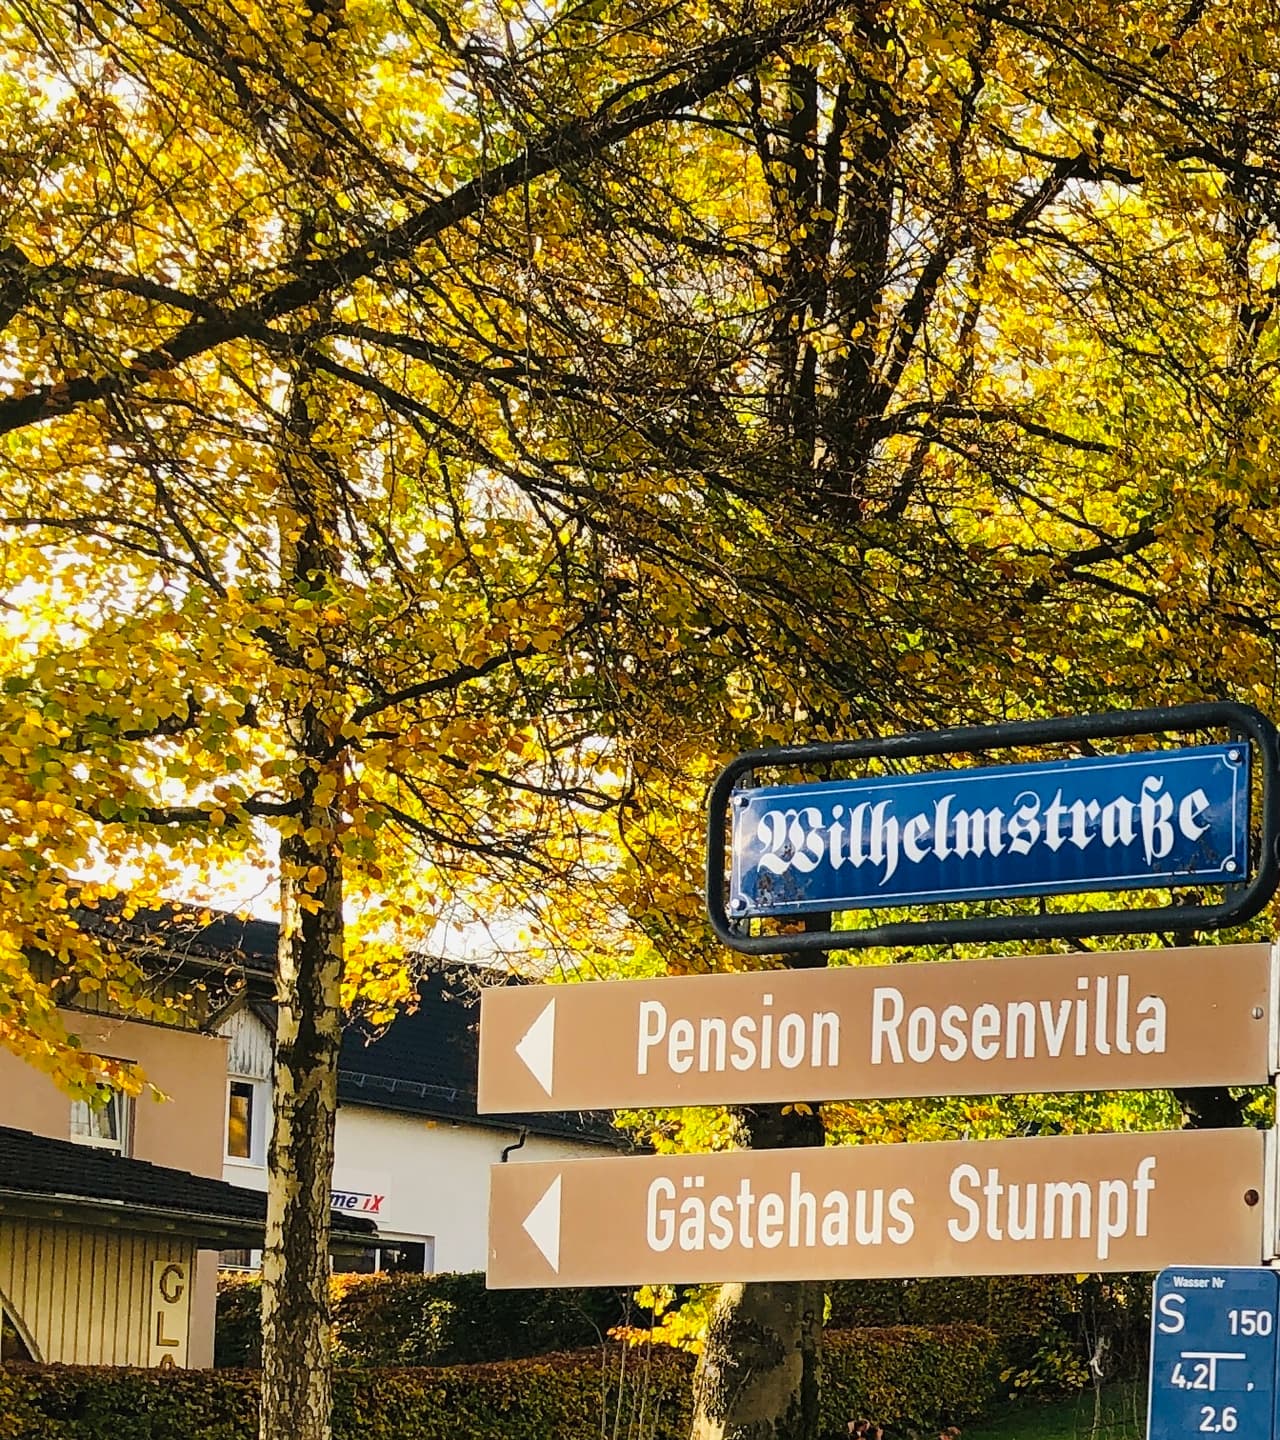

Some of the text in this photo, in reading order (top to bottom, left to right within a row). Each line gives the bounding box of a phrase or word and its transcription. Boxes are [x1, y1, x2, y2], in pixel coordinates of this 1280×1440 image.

[756, 776, 1212, 885] Wilhelmstraße
[637, 975, 1168, 1076] Pension Rosenvilla
[646, 1156, 1157, 1261] Gästehaus Stumpf
[1173, 1276, 1226, 1289] Wasser Nr
[1157, 1293, 1273, 1336] S 150
[1170, 1363, 1209, 1390] 4,2
[1200, 1406, 1238, 1433] 2,6
